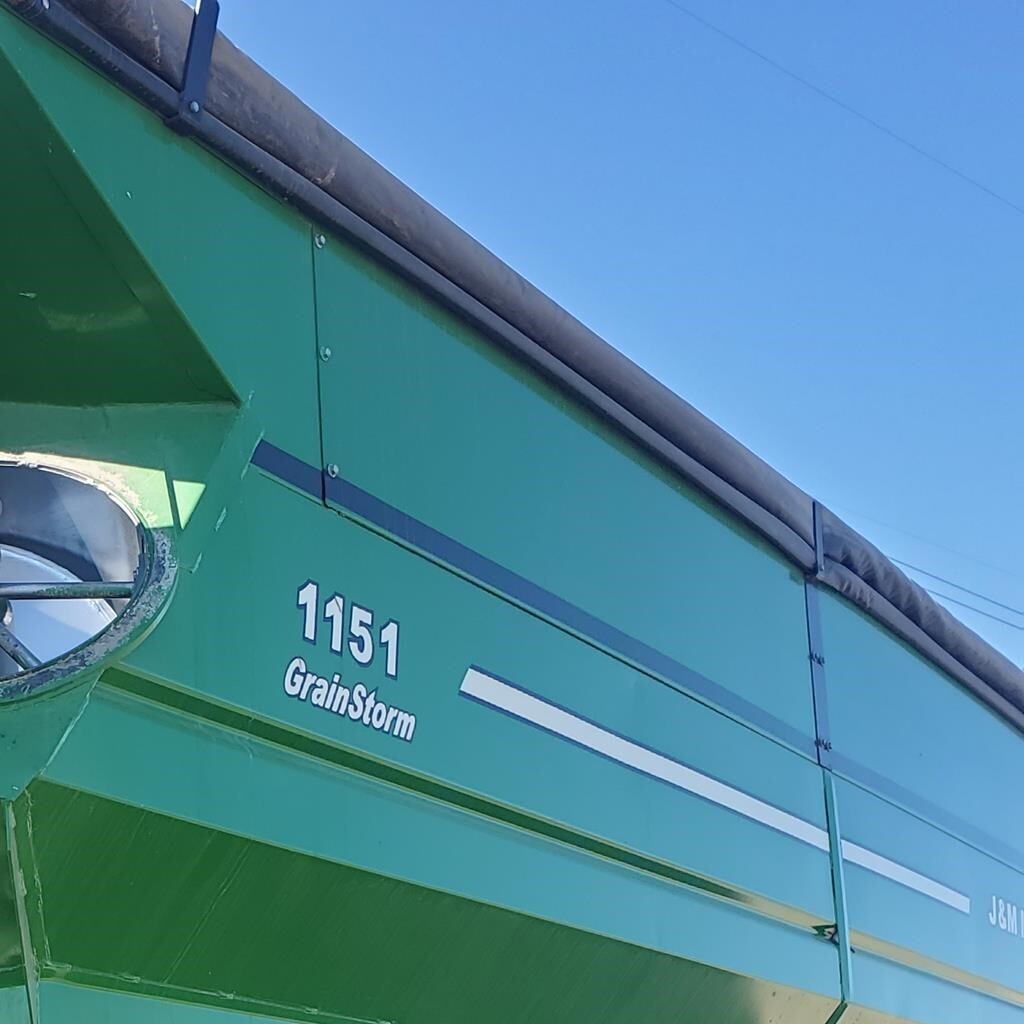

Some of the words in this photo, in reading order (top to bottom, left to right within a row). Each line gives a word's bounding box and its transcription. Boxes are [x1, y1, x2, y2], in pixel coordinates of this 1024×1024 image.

[297, 578, 399, 680] 1151
[283, 656, 416, 742] GrainStorm
[988, 895, 1017, 936] J&M
